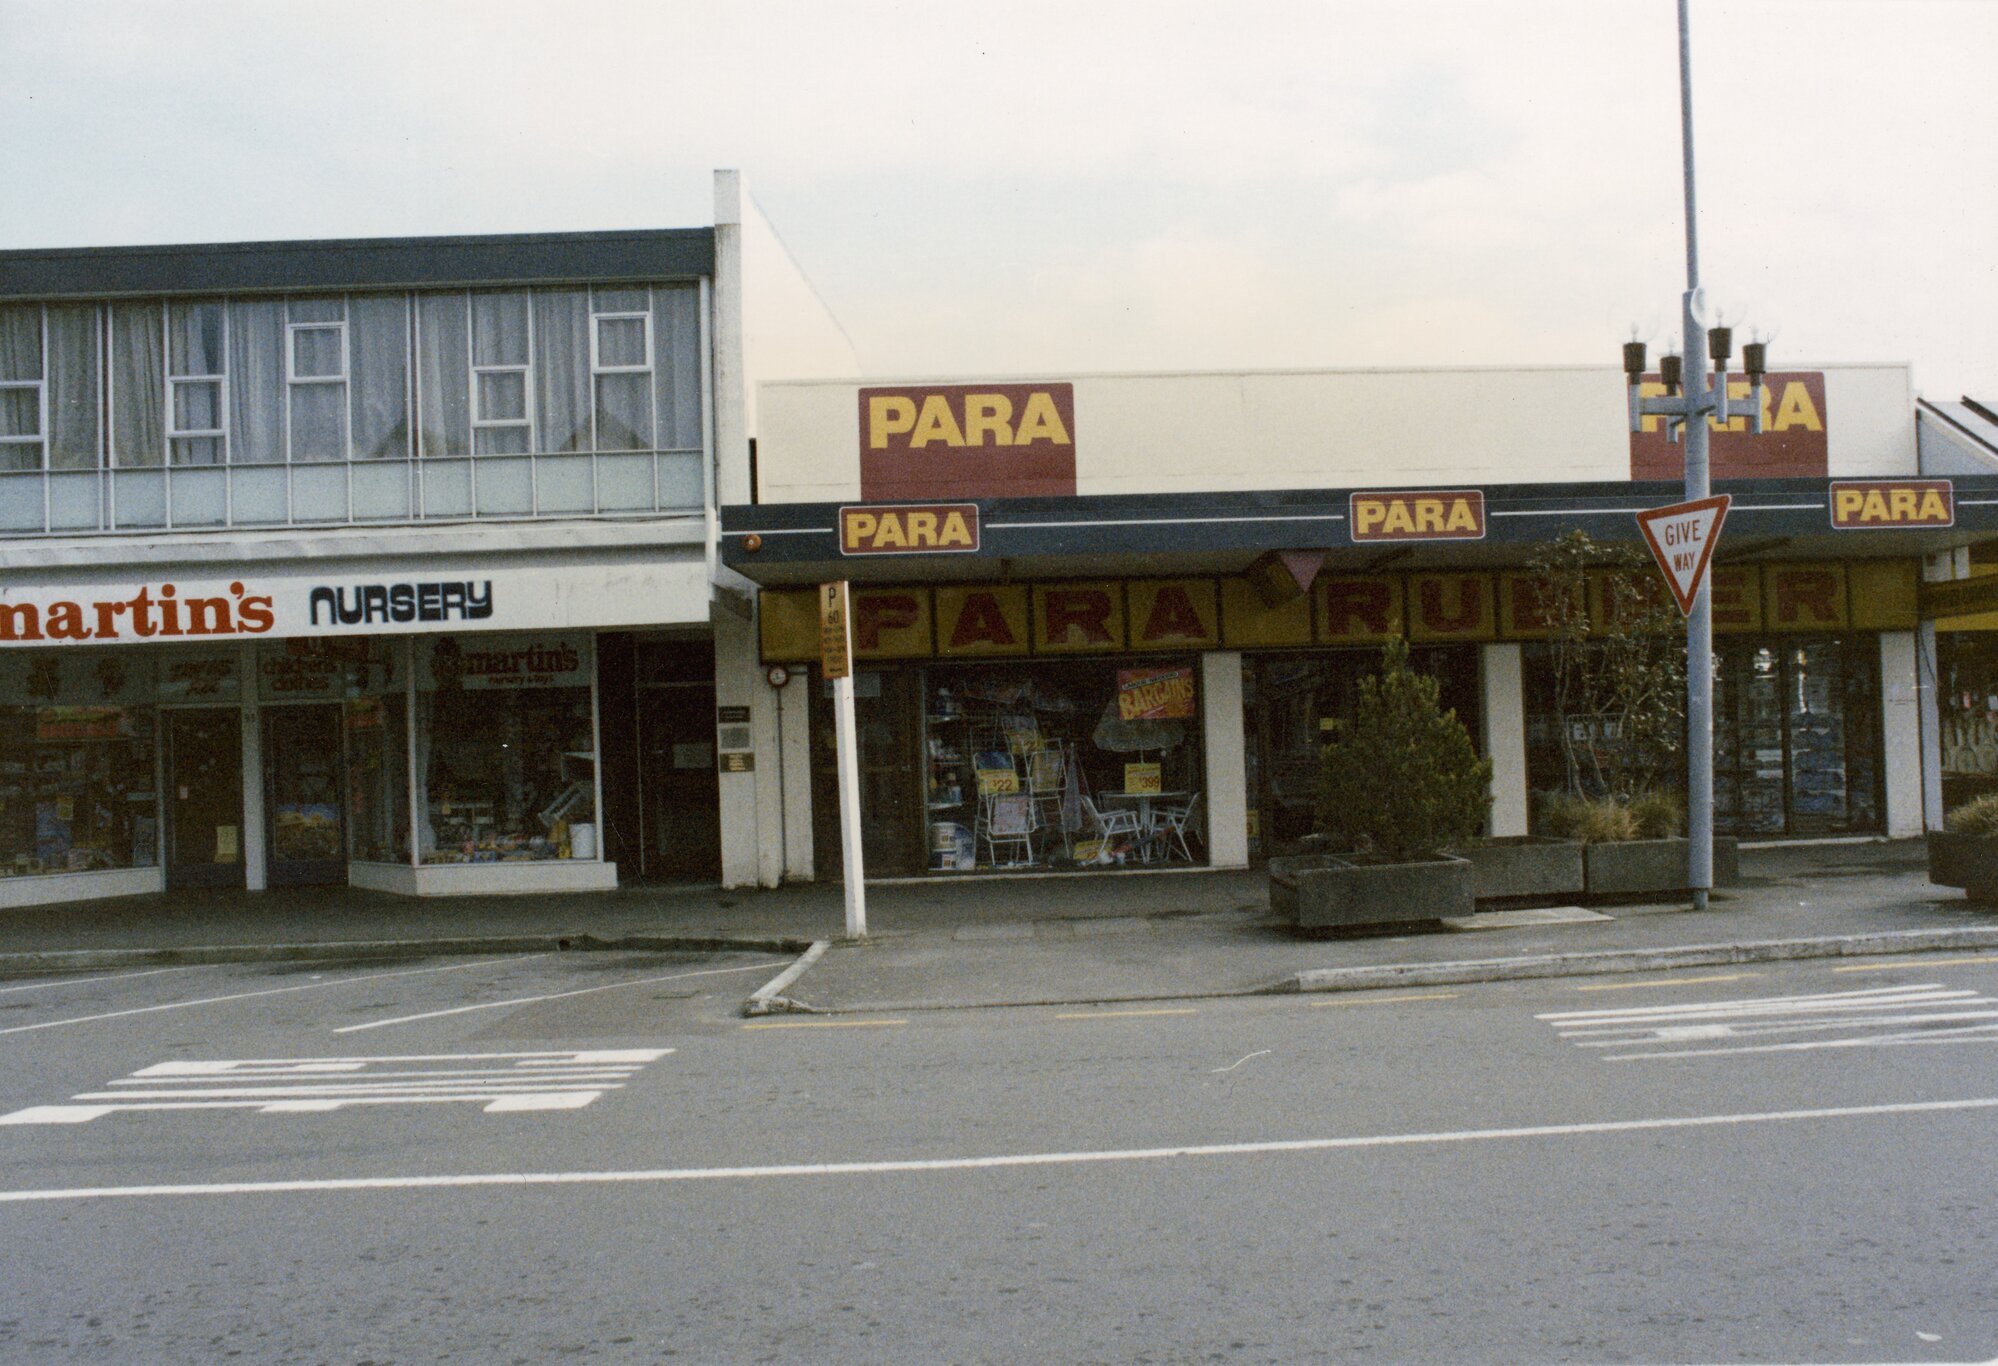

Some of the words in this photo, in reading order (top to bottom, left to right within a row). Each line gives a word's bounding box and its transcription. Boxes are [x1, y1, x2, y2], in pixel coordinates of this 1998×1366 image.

[869, 393, 1071, 449] PARA
[1358, 500, 1476, 533] PARA
[1836, 489, 1949, 521] PARA
[846, 511, 973, 549] PARA
[1664, 519, 1702, 546] GIVE
[1673, 552, 1696, 573] WAY
[0, 582, 274, 640] martin's
[828, 586, 837, 608] P
[857, 585, 1208, 651] PARA
[464, 642, 579, 674] martin's
[1119, 678, 1194, 720] BARGAINS
[992, 778, 1013, 791] $22
